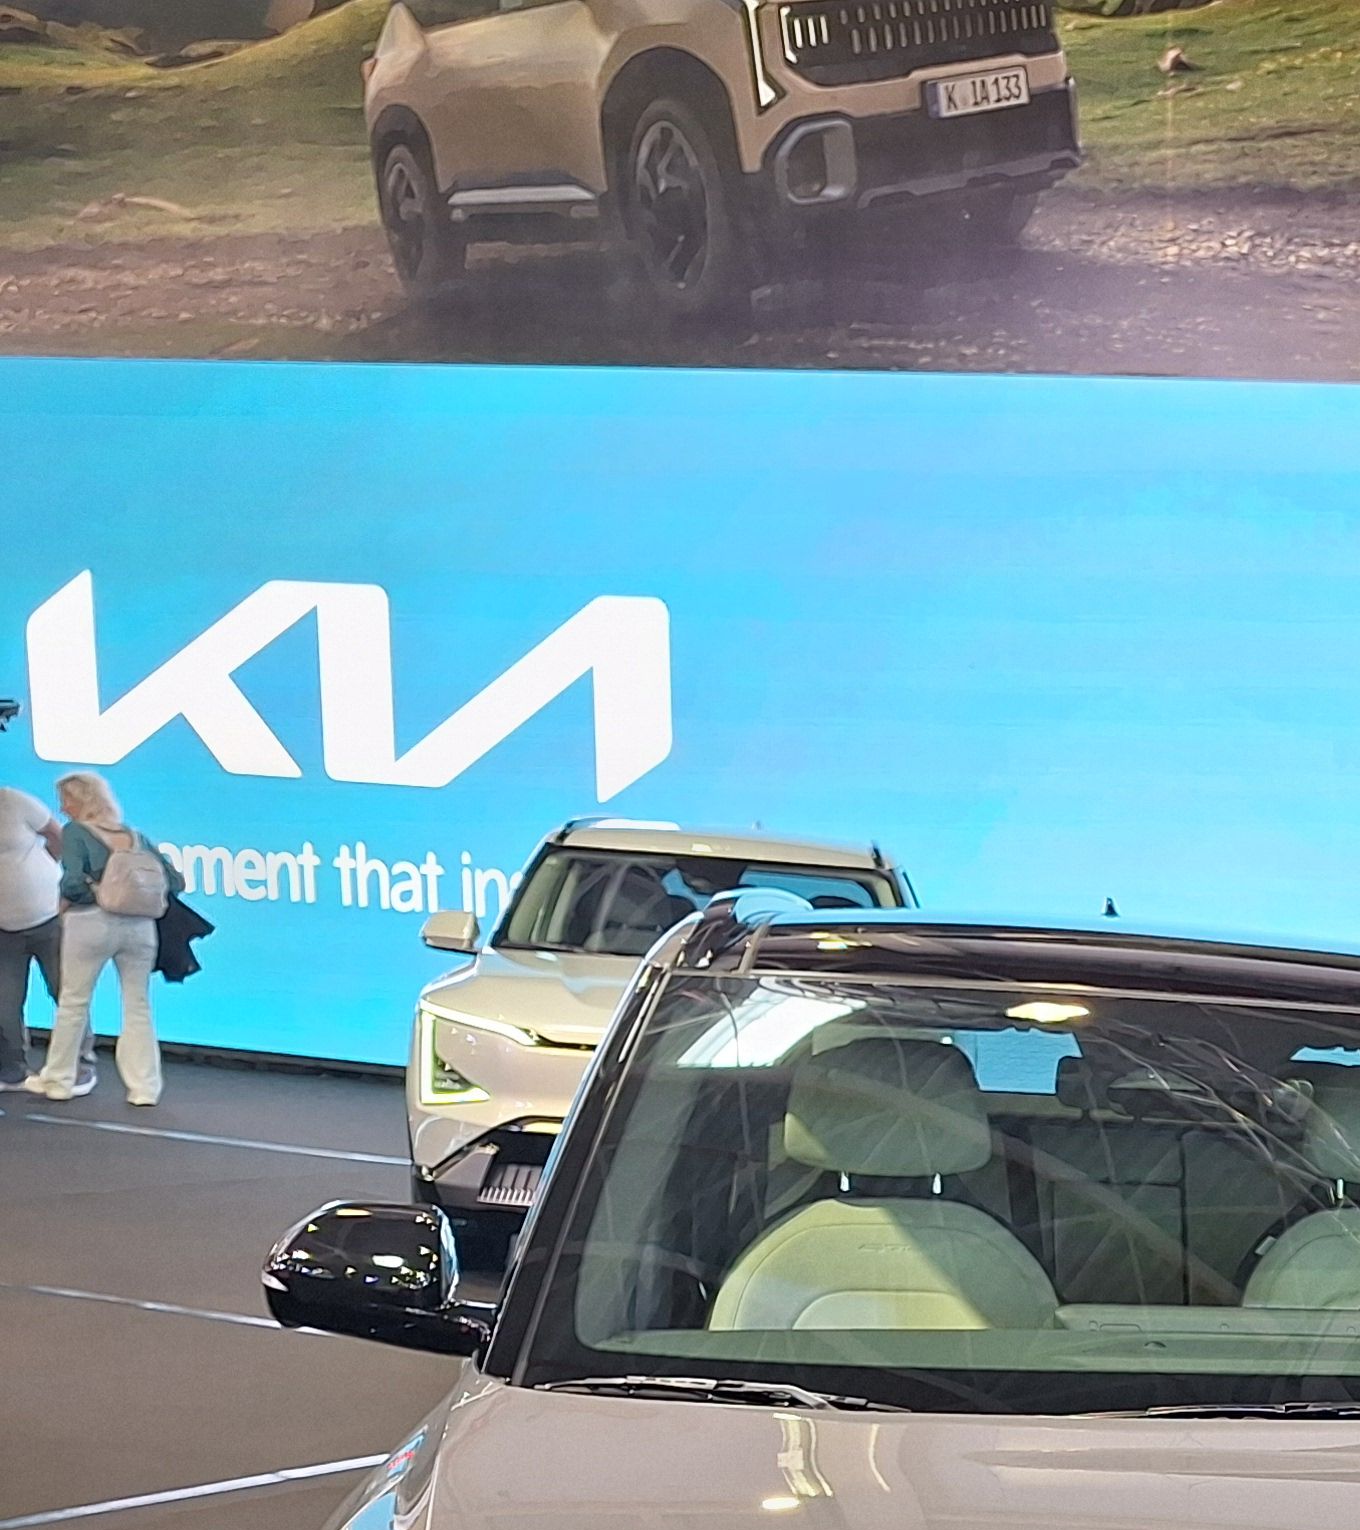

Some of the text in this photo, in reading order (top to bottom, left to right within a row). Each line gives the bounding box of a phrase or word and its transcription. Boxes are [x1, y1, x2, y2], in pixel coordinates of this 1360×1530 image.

[945, 84, 958, 112] K
[26, 568, 672, 803] KIA
[158, 840, 522, 917] ment that in
